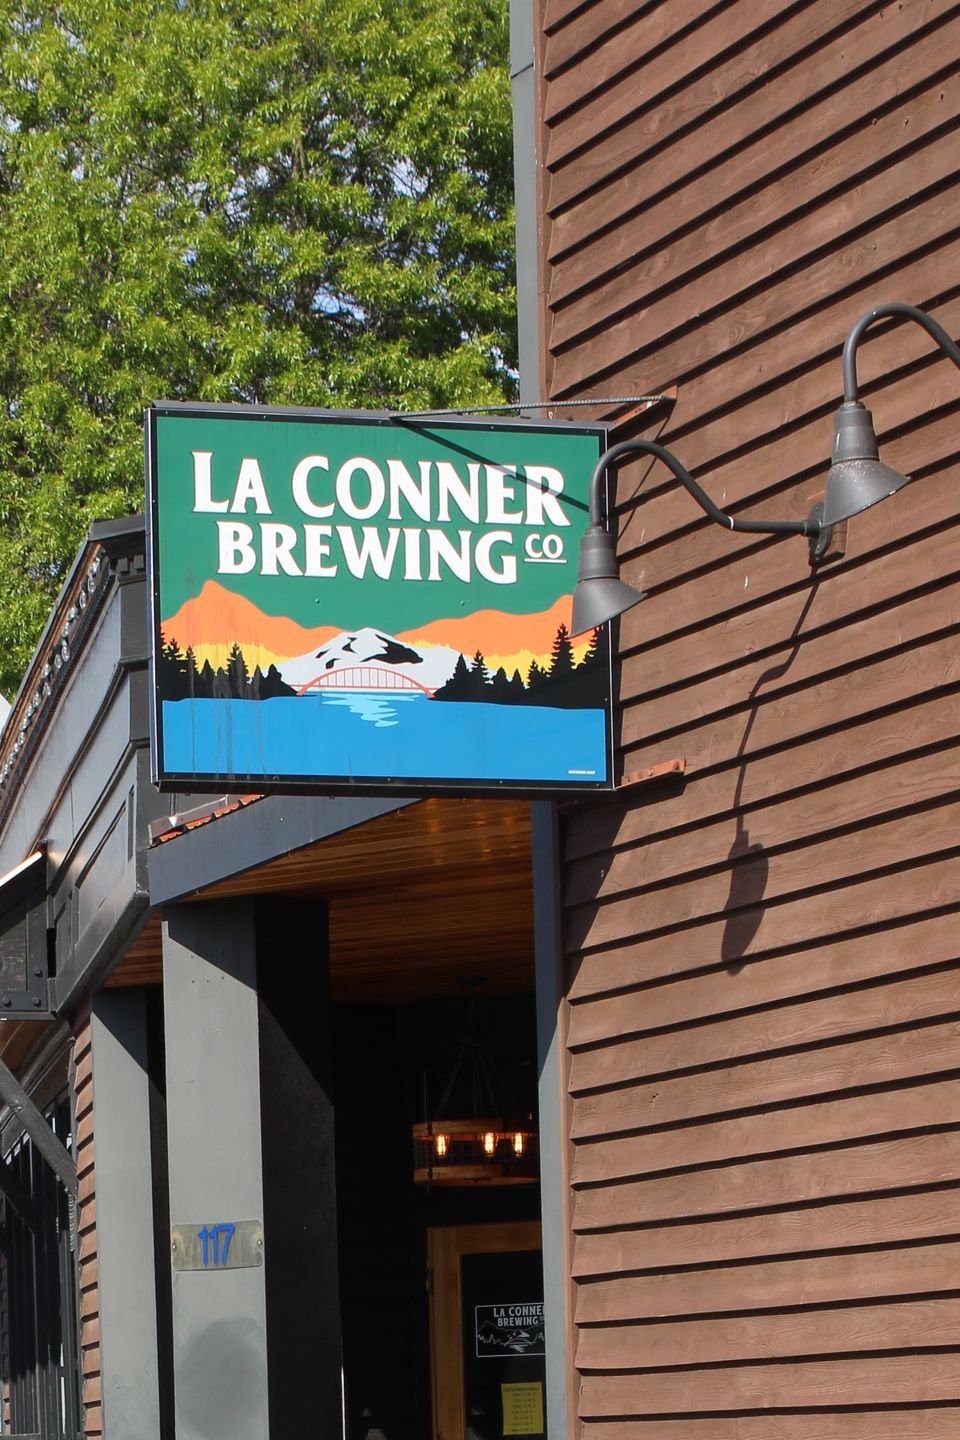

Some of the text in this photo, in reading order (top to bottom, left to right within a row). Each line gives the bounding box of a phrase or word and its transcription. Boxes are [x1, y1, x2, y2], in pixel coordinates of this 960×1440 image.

[192, 450, 572, 528] LA CONNER
[215, 520, 564, 585] BREWING CO
[197, 1221, 235, 1267] 117
[493, 1305, 544, 1318] LA CONNE
[498, 1316, 539, 1327] BREWING
